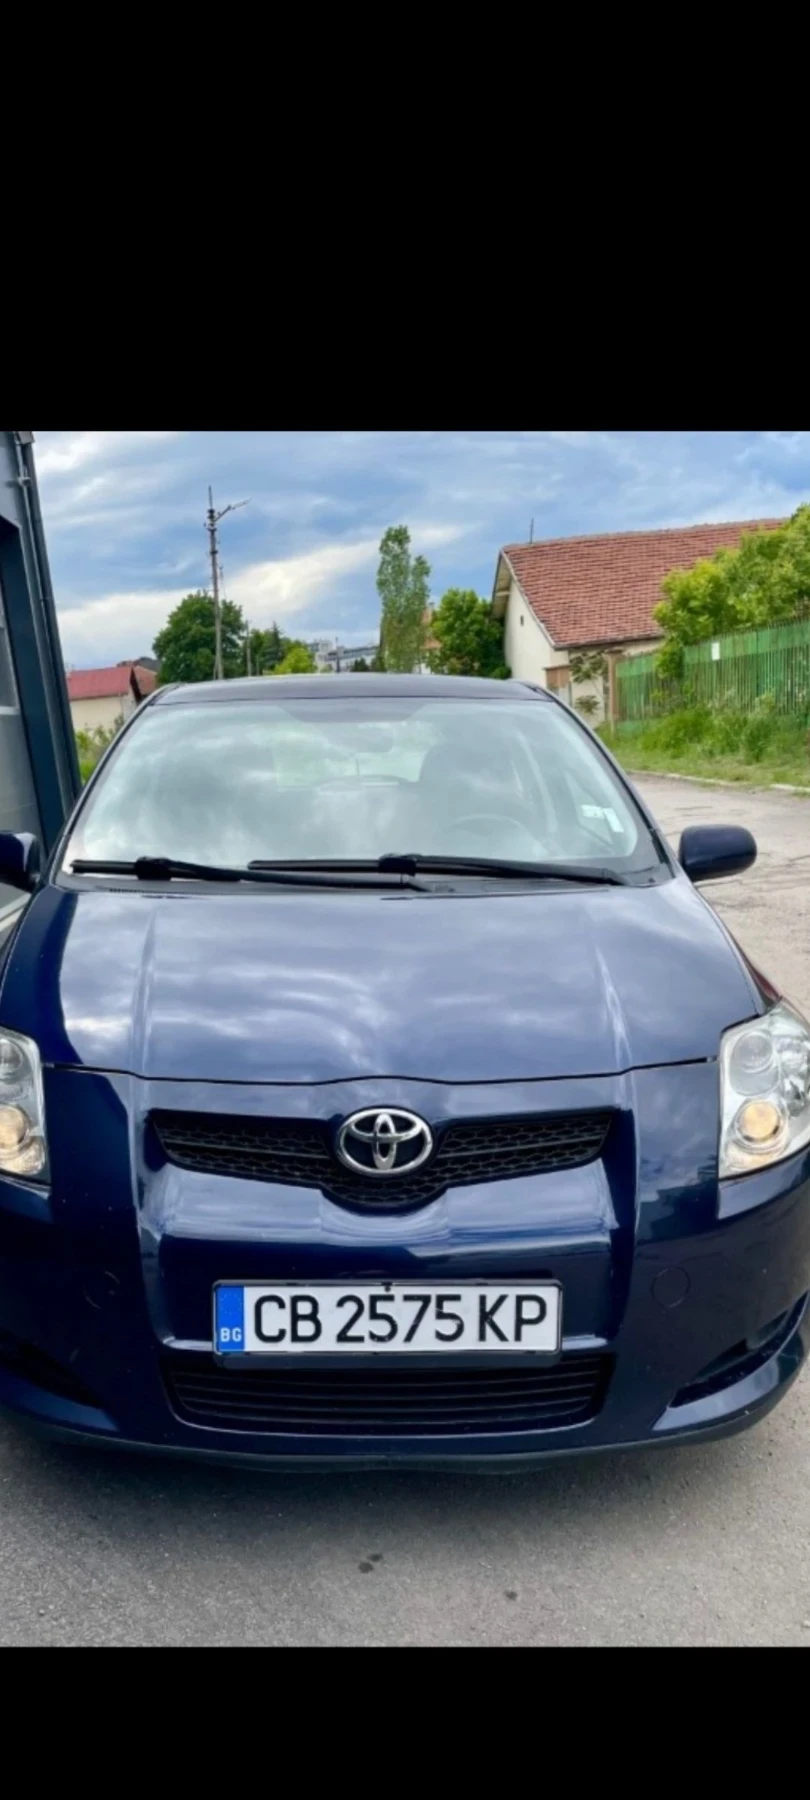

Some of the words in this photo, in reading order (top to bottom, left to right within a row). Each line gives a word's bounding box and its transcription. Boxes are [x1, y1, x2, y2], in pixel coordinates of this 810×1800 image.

[254, 1294, 322, 1343] CB
[336, 1294, 465, 1343] 2575
[478, 1294, 547, 1342] KP
[220, 1328, 242, 1342] BG
